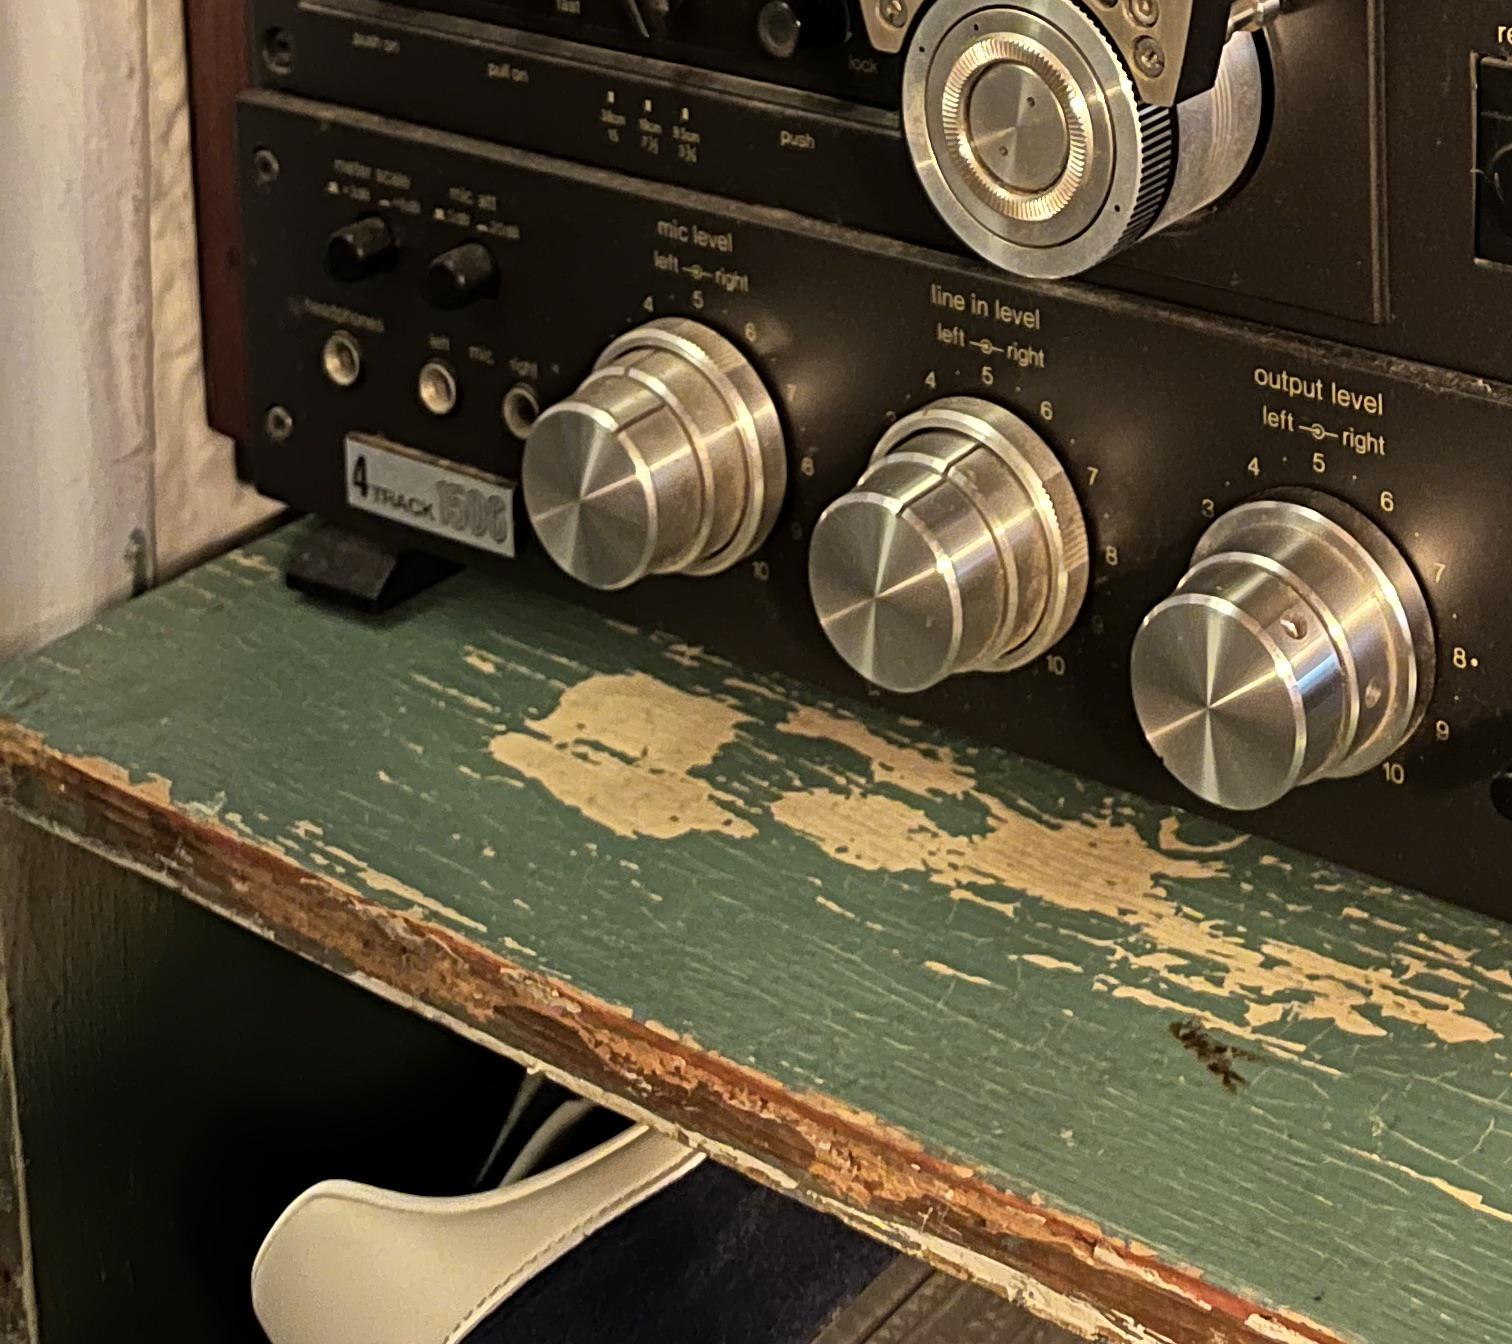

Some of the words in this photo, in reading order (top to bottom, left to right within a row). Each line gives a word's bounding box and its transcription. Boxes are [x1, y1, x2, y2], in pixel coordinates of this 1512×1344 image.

[779, 129, 816, 150] push
[656, 219, 689, 243] mic
[692, 224, 734, 253] level
[653, 249, 680, 274] left
[715, 267, 749, 293] right
[642, 295, 654, 313] 4
[692, 290, 705, 310] 5
[744, 321, 757, 342] 6
[930, 283, 966, 313] line
[971, 292, 990, 318] in
[994, 298, 1041, 331] level
[936, 321, 966, 349] left
[1005, 341, 1046, 369] right
[924, 370, 937, 390] 4
[981, 367, 995, 387] 5
[1253, 365, 1324, 401] output
[1331, 381, 1384, 416] level
[1040, 400, 1054, 421] 6
[1262, 405, 1296, 432] left
[1342, 427, 1386, 456] right
[1247, 456, 1261, 476] 4
[1312, 453, 1327, 473] 5
[1087, 466, 1099, 486] 7
[1380, 490, 1395, 512] 6
[1105, 544, 1119, 566] 8
[1433, 562, 1447, 585] 7
[1046, 654, 1066, 676] 10
[1452, 647, 1468, 670] 8
[1435, 719, 1451, 742] 9
[1383, 761, 1405, 786] 10
